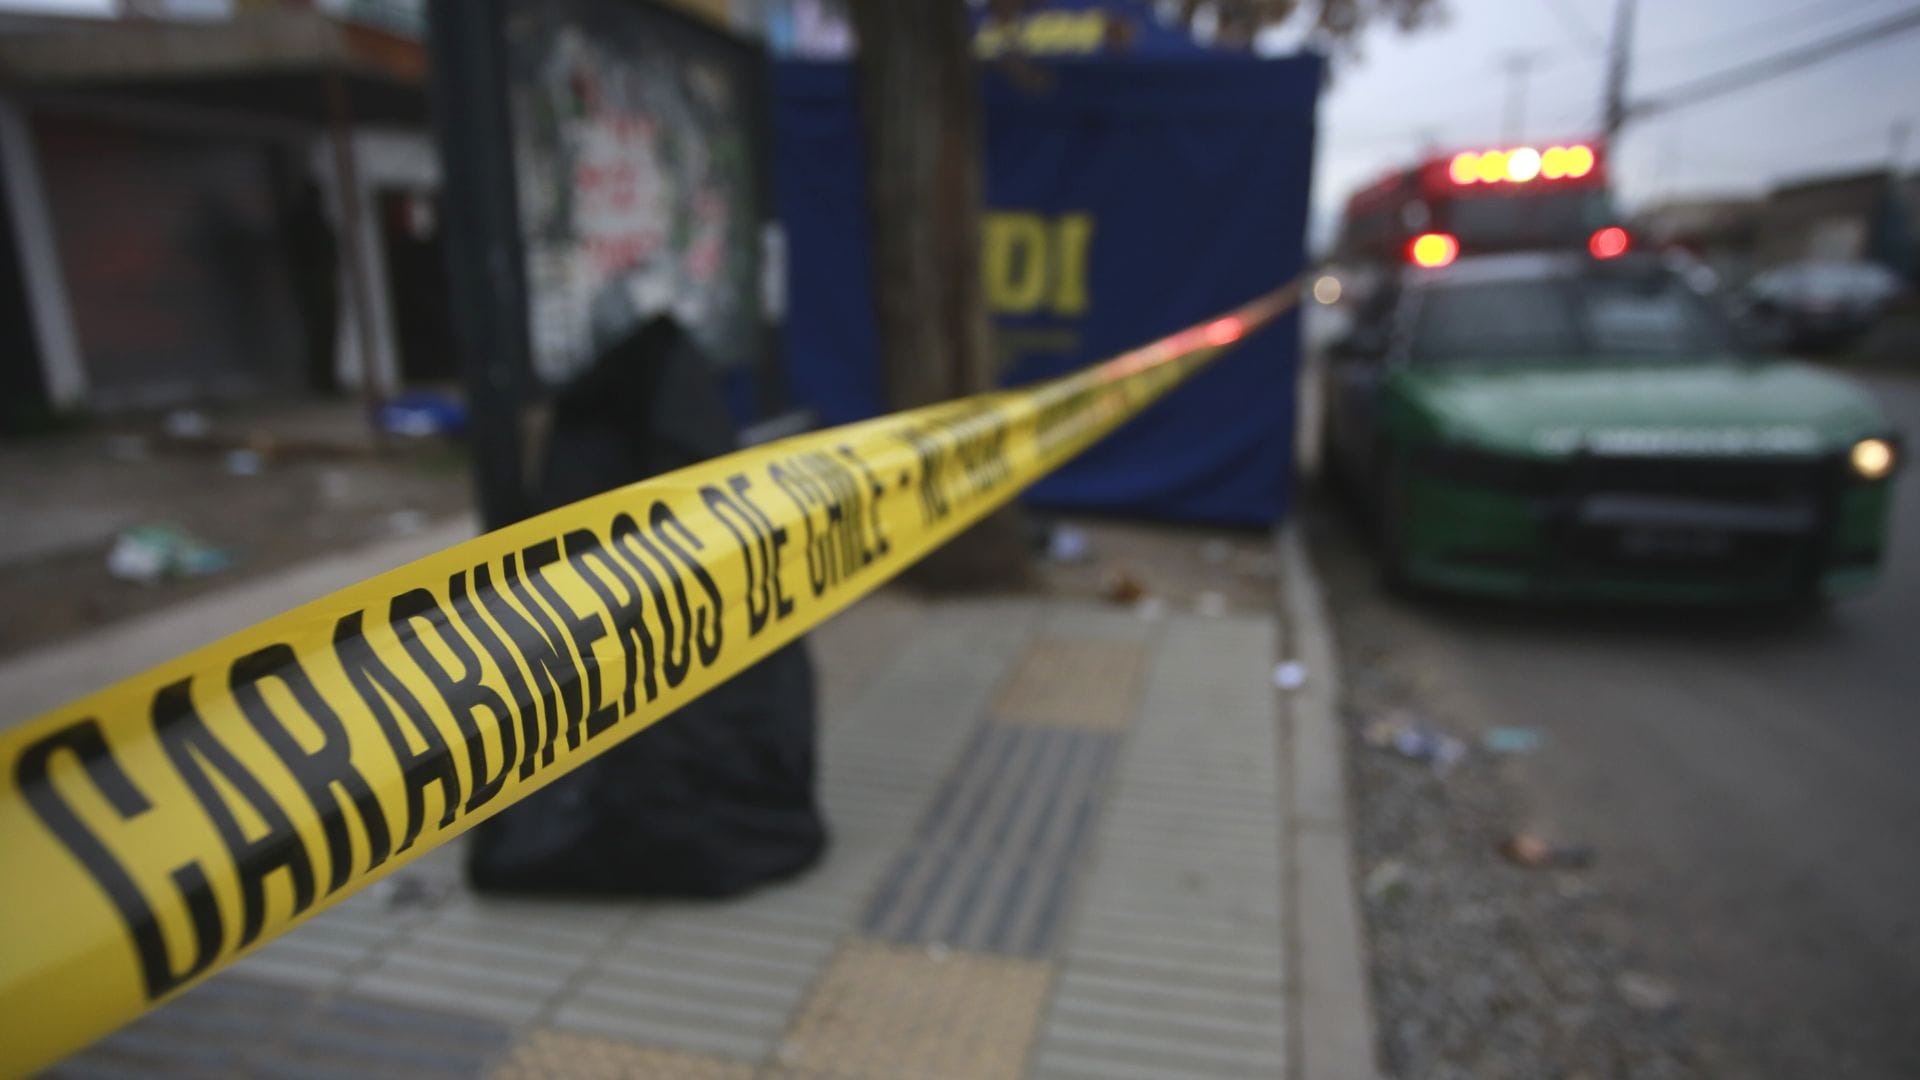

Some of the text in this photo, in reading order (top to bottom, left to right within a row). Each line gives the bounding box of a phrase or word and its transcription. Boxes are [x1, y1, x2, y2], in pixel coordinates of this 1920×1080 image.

[982, 213, 1091, 313] DI
[13, 501, 724, 1001] CARABINEROS
[699, 474, 794, 638] DE
